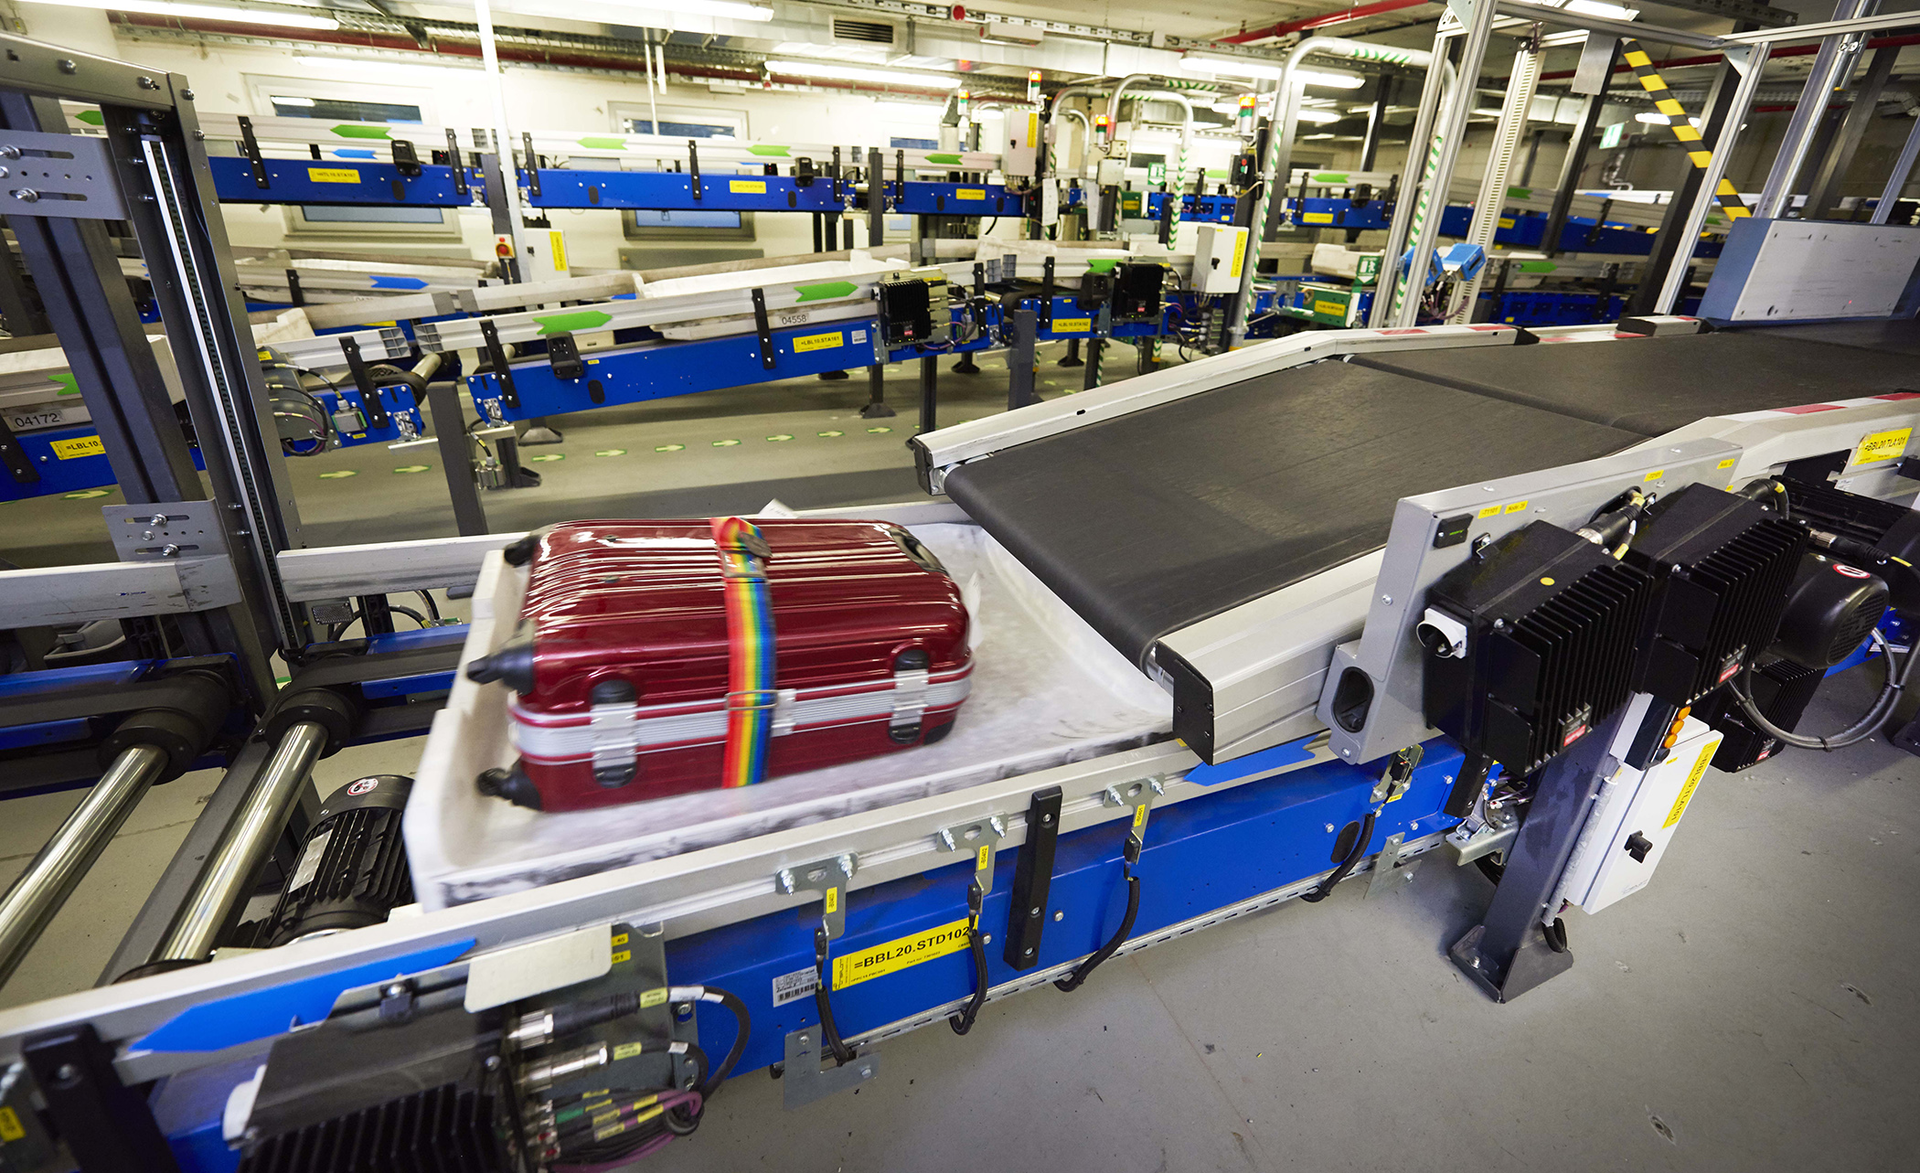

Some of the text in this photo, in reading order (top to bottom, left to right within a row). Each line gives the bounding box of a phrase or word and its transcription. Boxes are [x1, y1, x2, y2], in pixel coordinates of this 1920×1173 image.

[781, 314, 807, 325] 04558
[14, 412, 60, 428] 04172
[853, 926, 970, 969] =BBL20.STD102
